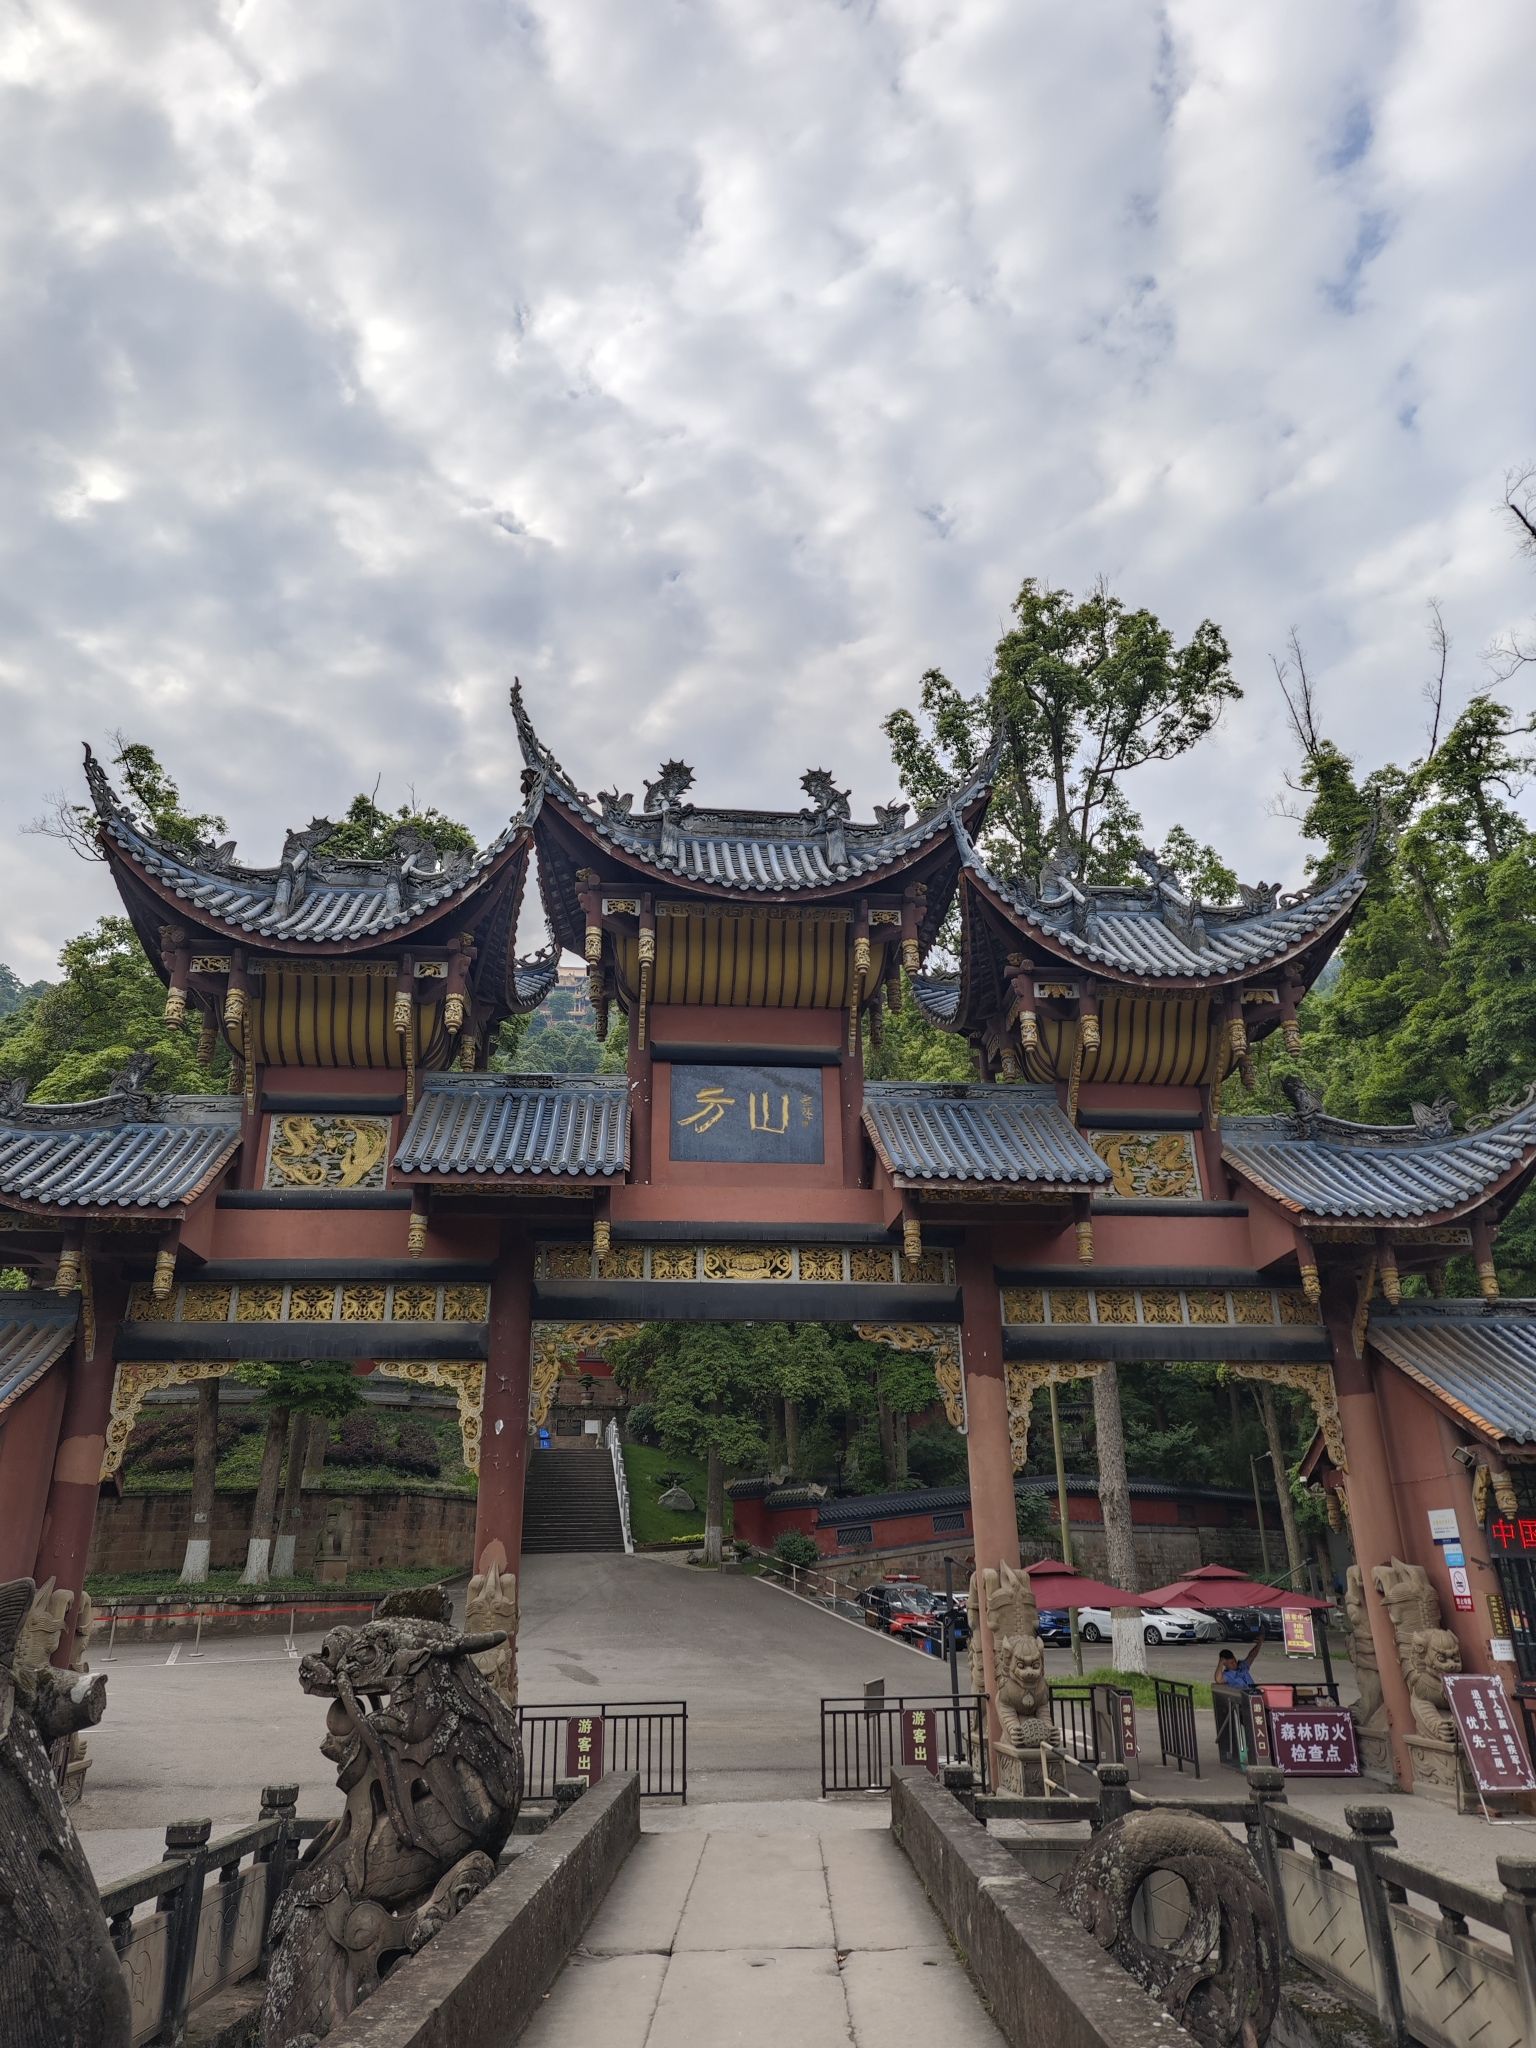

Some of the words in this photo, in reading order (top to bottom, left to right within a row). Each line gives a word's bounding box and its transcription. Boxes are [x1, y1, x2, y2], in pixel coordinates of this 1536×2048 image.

[677, 1087, 789, 1134] 方山
[1492, 1518, 1536, 1549] 中国
[912, 1711, 927, 1768] 游客出
[1253, 1703, 1266, 1750] 游客入口
[1280, 1722, 1347, 1741] 森林防火
[1466, 1716, 1486, 1748] 优先
[1290, 1744, 1341, 1762] 检查点
